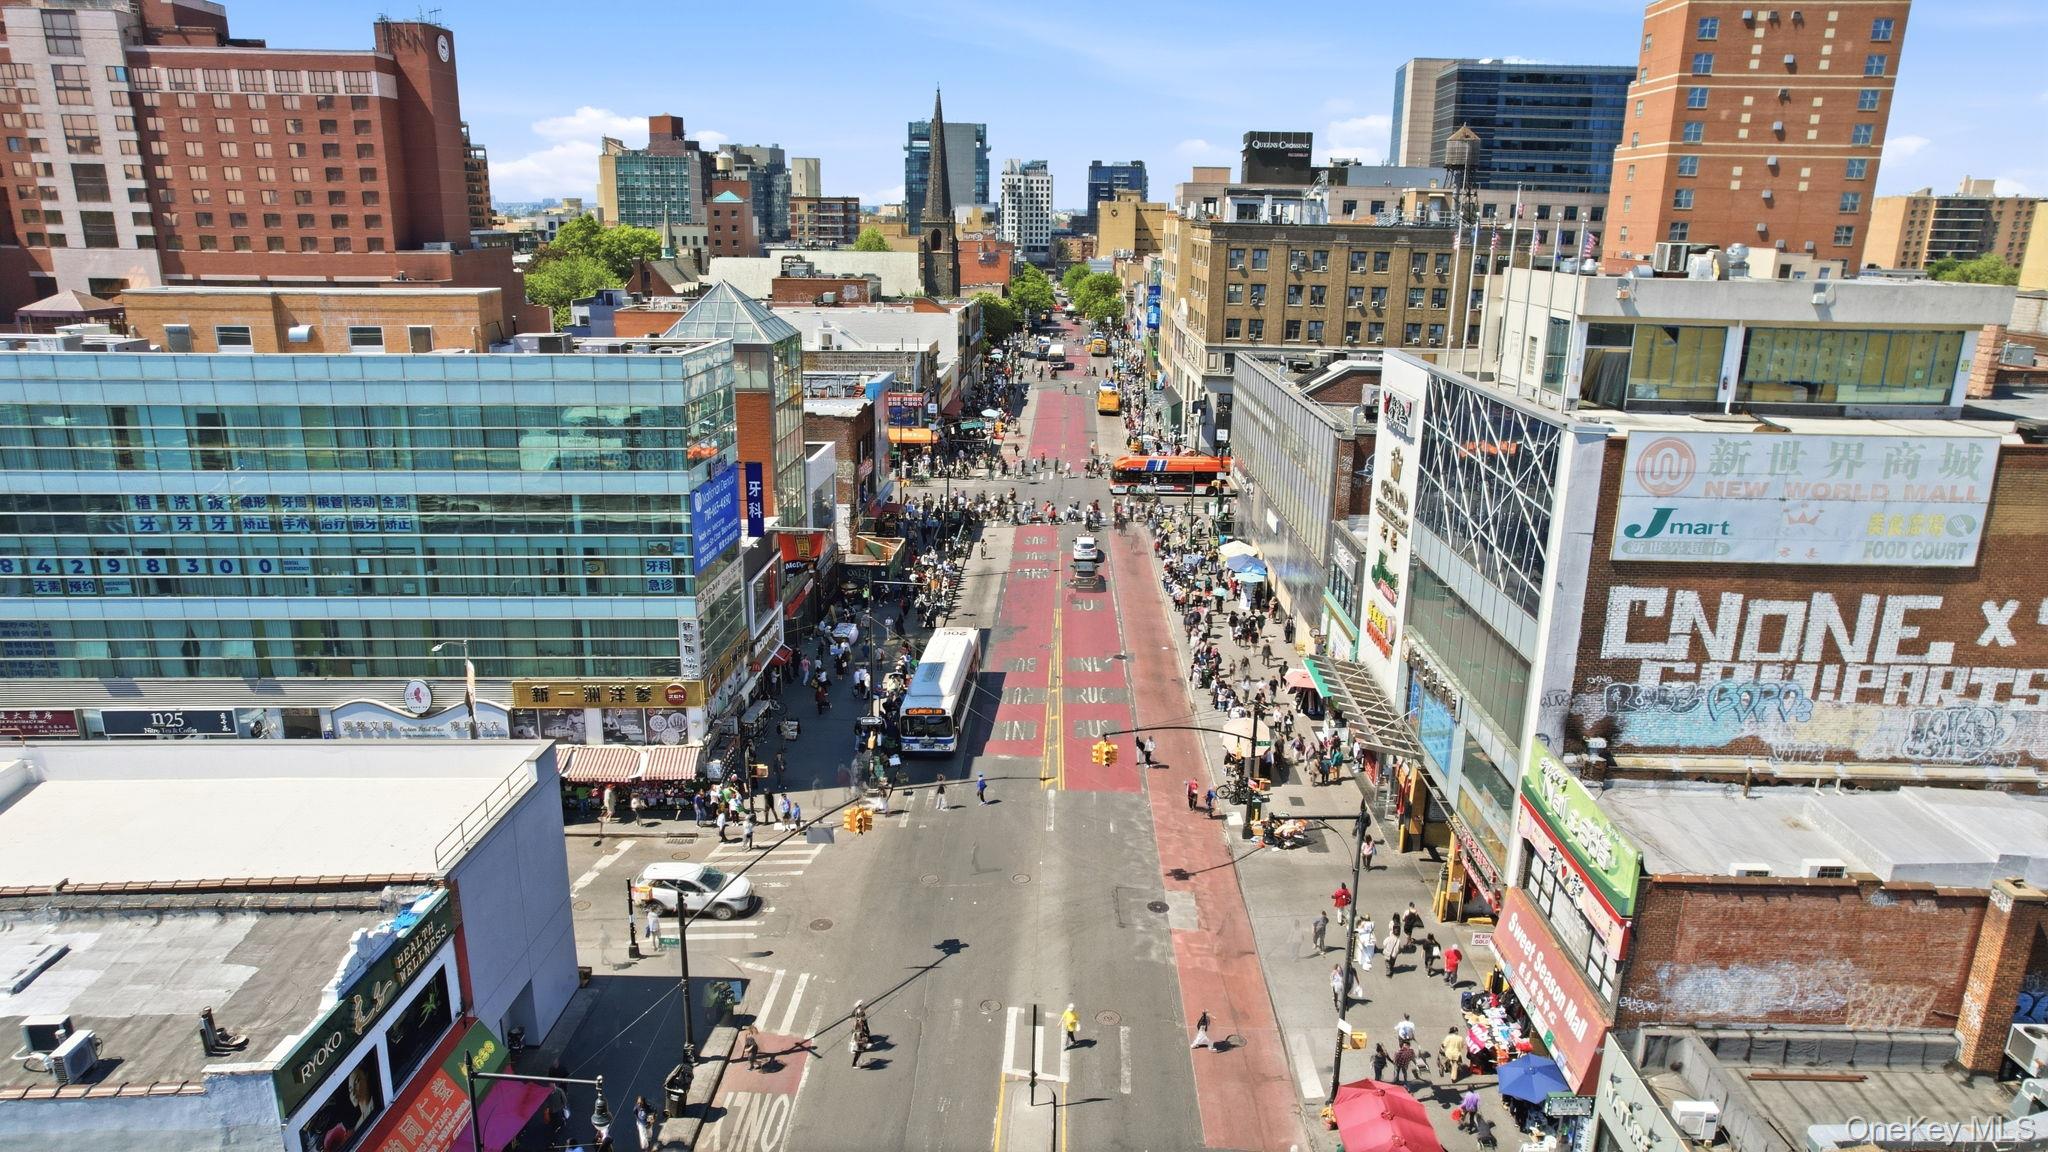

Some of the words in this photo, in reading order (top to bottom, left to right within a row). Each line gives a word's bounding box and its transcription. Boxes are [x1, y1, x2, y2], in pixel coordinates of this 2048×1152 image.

[1708, 438, 1985, 481] 新世界商城
[748, 481, 762, 519] 牙科
[1704, 481, 1770, 498] NEW
[1784, 482, 1889, 500] WORLD
[1904, 484, 1981, 501] MALL
[646, 560, 671, 573] 牙科
[1863, 541, 1908, 560] FOOD
[1911, 542, 1968, 560] COURT
[68, 580, 96, 592] 预约
[648, 579, 674, 592] 急诊
[397, 921, 435, 969] HEALTH
[398, 924, 448, 984] WELLNESS
[1509, 912, 1537, 962] Sweet
[1534, 952, 1567, 1012] Season
[1563, 998, 1589, 1043] Mall
[301, 1031, 342, 1084] RYOKO
